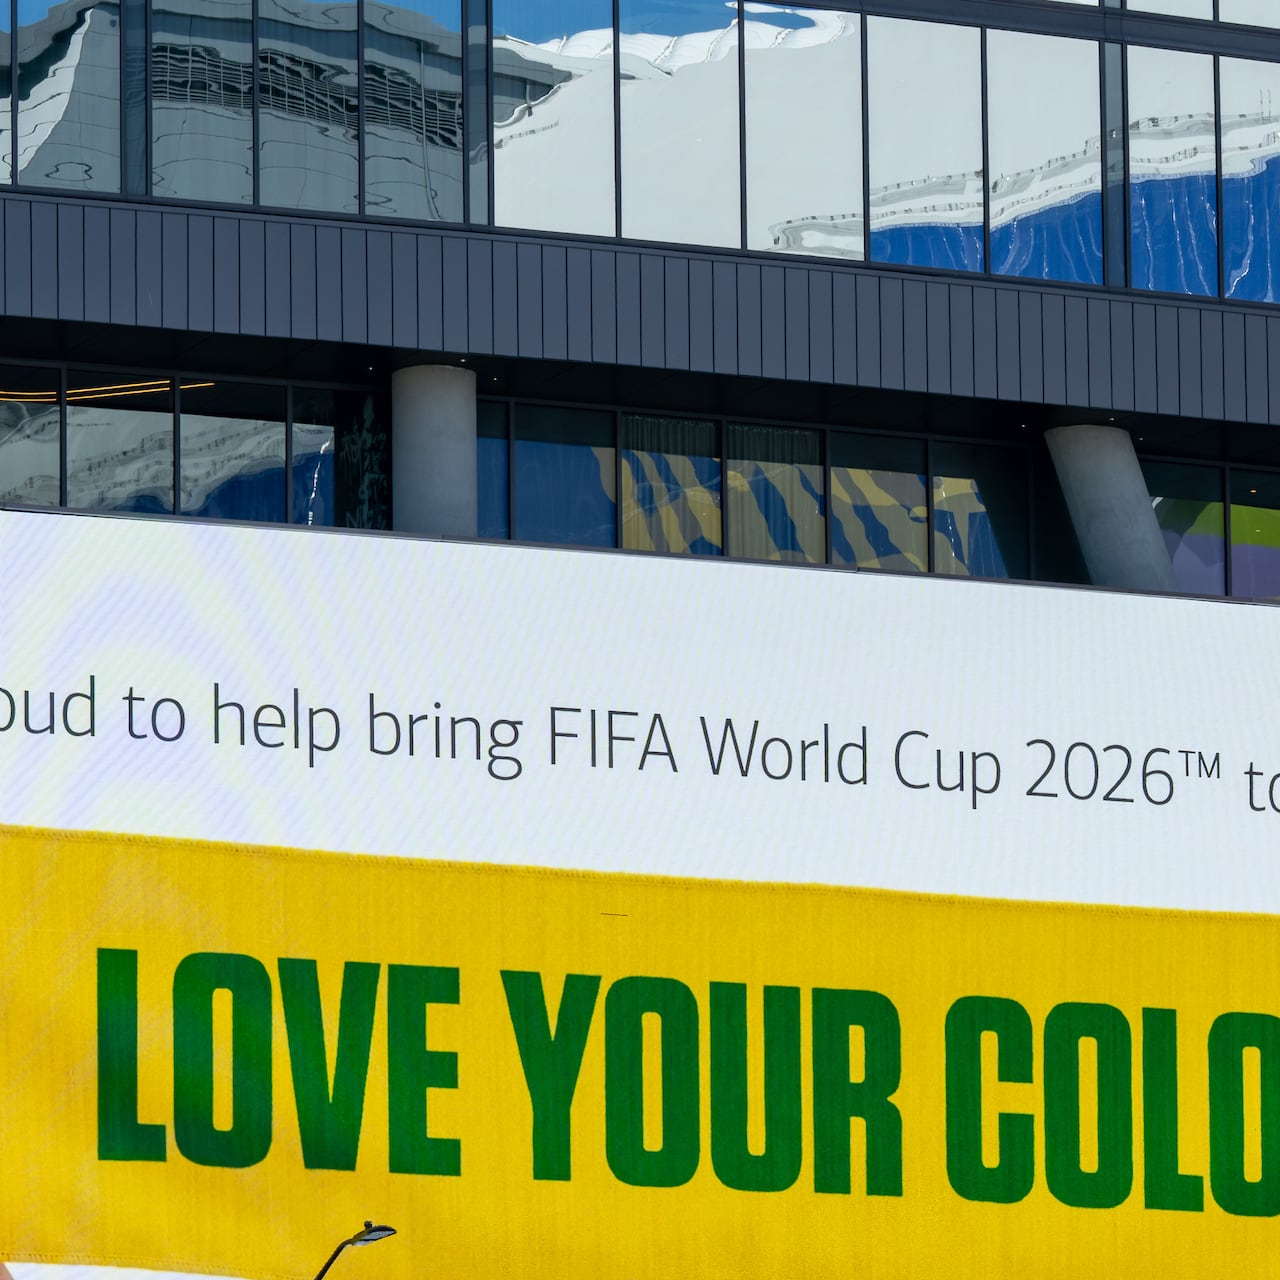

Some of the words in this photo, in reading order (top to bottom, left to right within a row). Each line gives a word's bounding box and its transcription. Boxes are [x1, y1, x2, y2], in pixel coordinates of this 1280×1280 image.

[122, 686, 186, 742] to
[214, 682, 341, 768] help
[369, 692, 523, 781] bring
[548, 706, 678, 773] FIFA
[699, 715, 869, 786] World
[893, 729, 1003, 810] Cup
[96, 946, 462, 1177] LOVE
[500, 969, 903, 1198] YOUR
